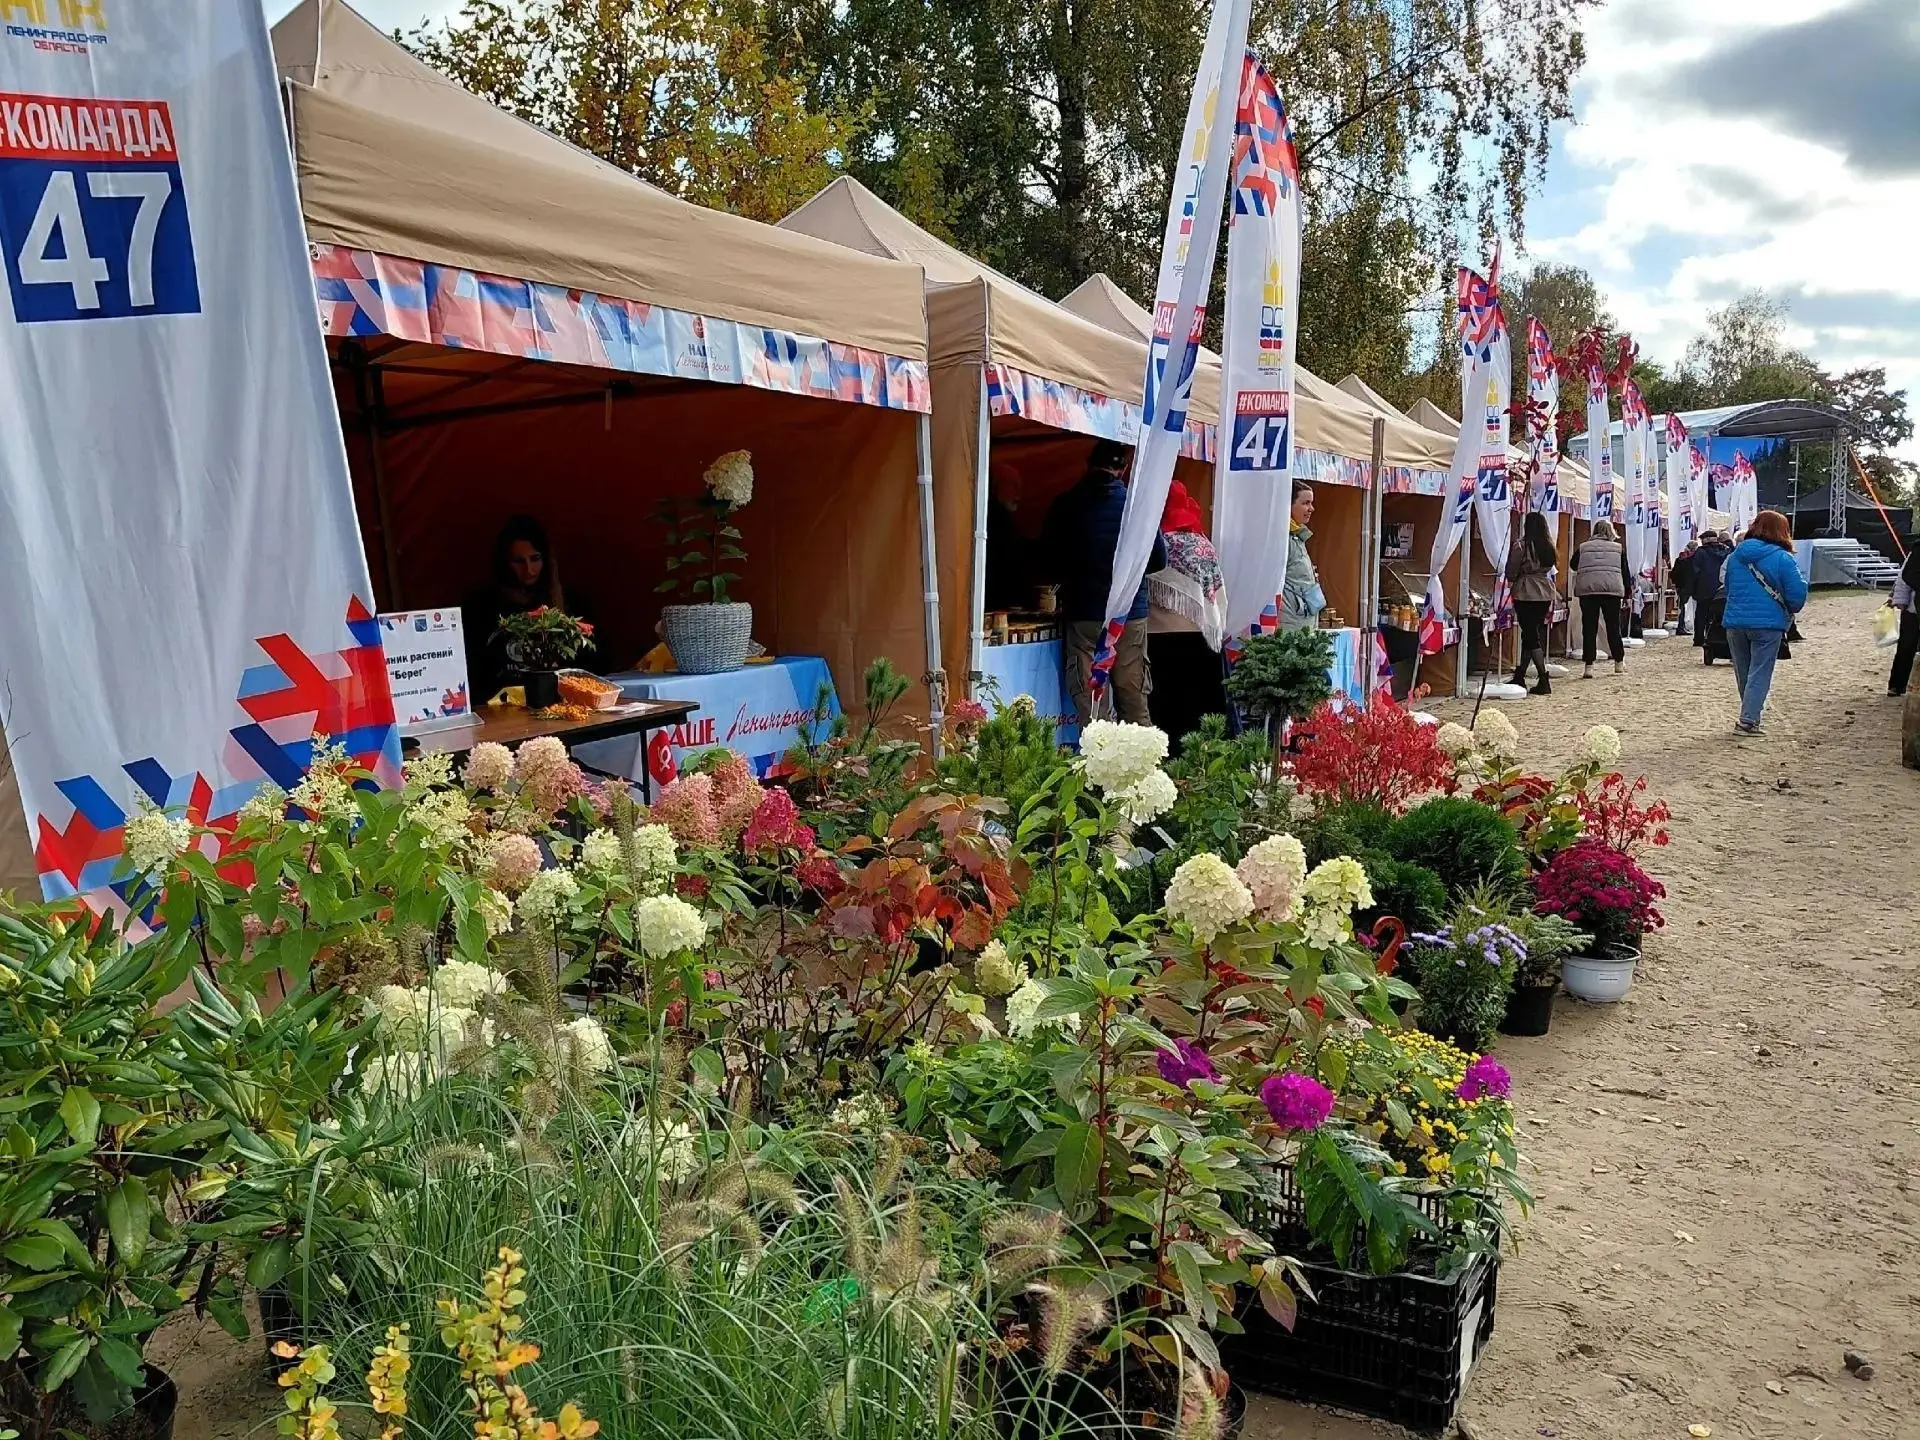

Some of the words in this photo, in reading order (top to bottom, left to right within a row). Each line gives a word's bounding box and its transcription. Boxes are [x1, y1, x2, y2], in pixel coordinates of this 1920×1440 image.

[7, 25, 108, 44] ЛЕНИНГРАДСКАЯ
[33, 40, 87, 54] ОБЛАСТЬ
[0, 101, 172, 157] КОМАНДА
[18, 171, 171, 309] 47
[1236, 418, 1287, 468] 47
[410, 646, 453, 664] растений
